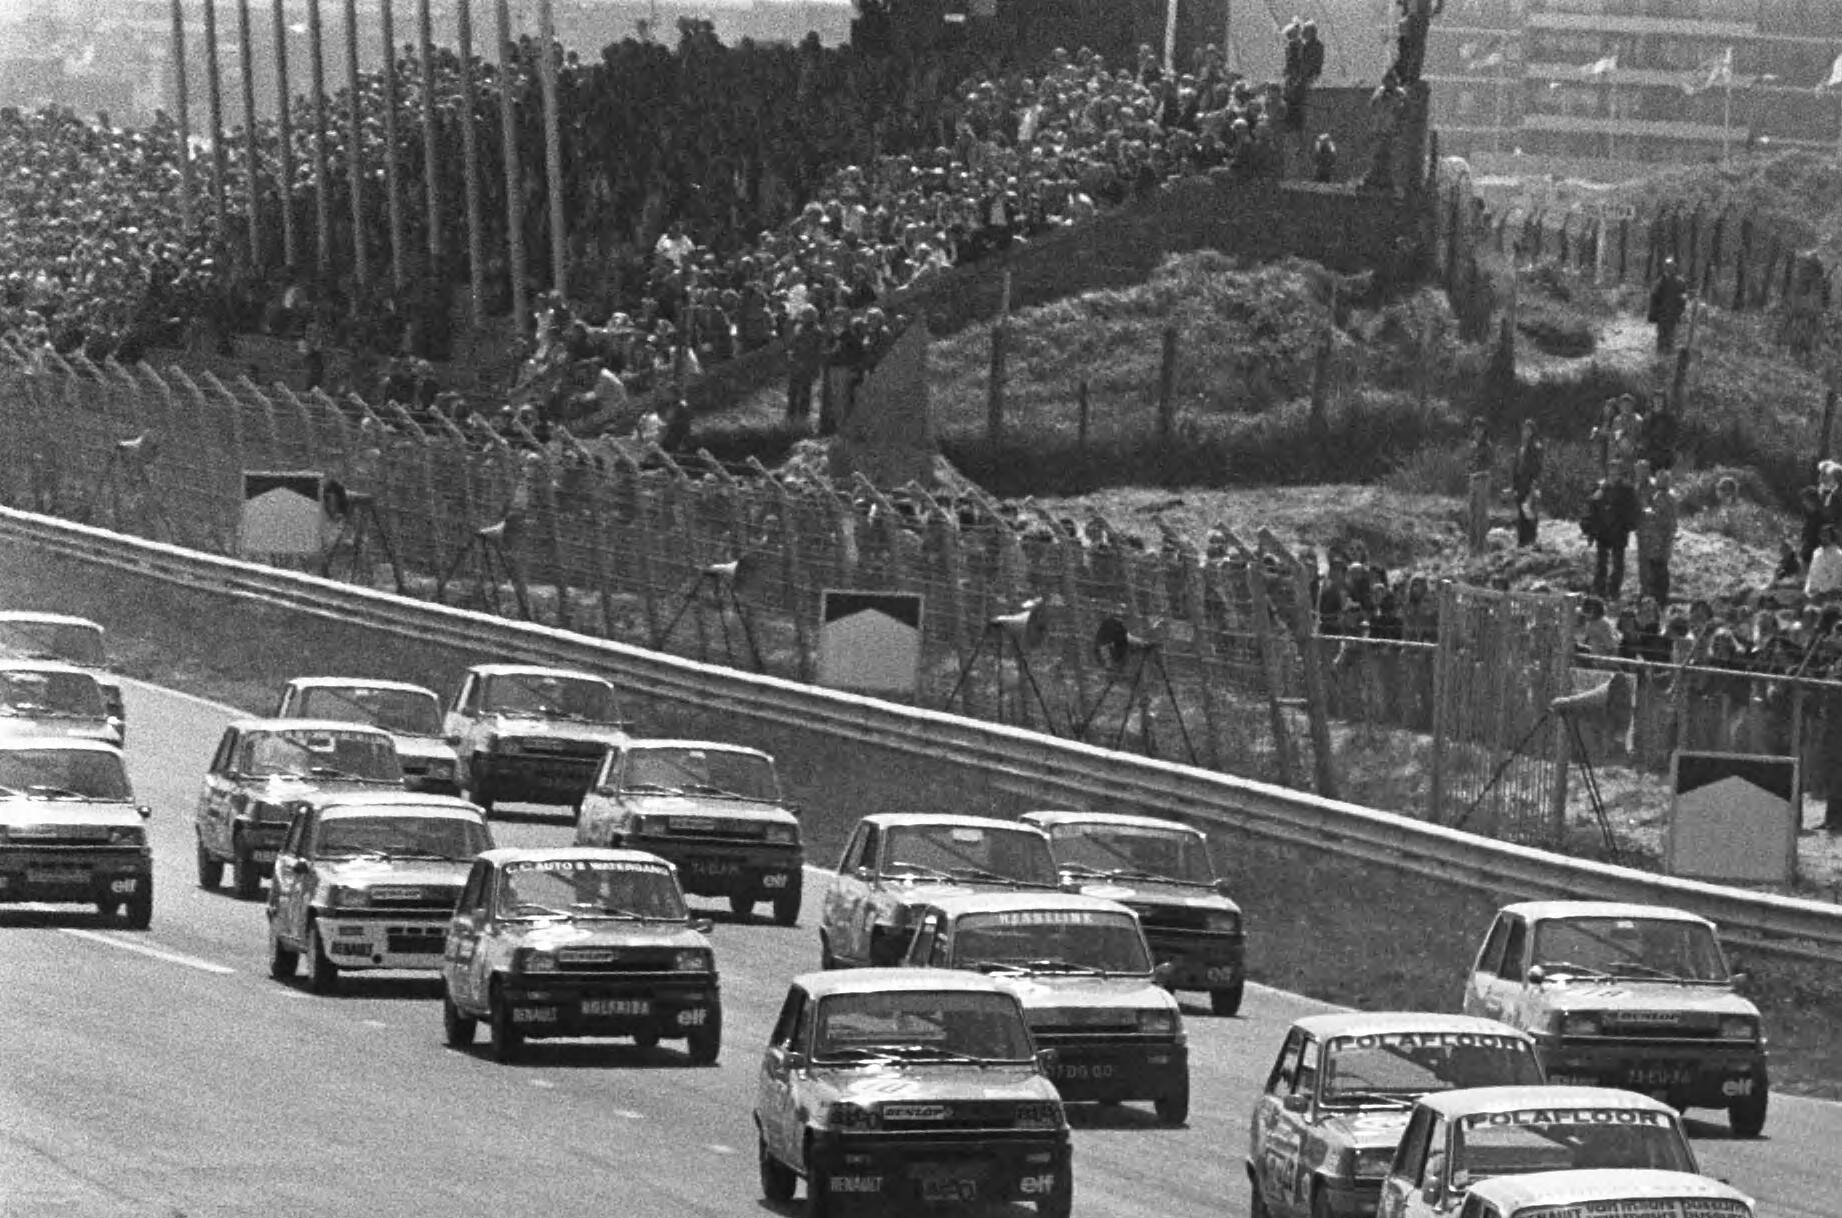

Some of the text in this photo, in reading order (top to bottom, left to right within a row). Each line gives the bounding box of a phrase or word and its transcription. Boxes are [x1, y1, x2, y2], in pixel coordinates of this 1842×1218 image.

[1334, 1033, 1519, 1051] POLAFLOOR
[1721, 1078, 1753, 1096] elf
[1466, 1108, 1660, 1129] POLAFLOOR
[1019, 1174, 1055, 1194] elf
